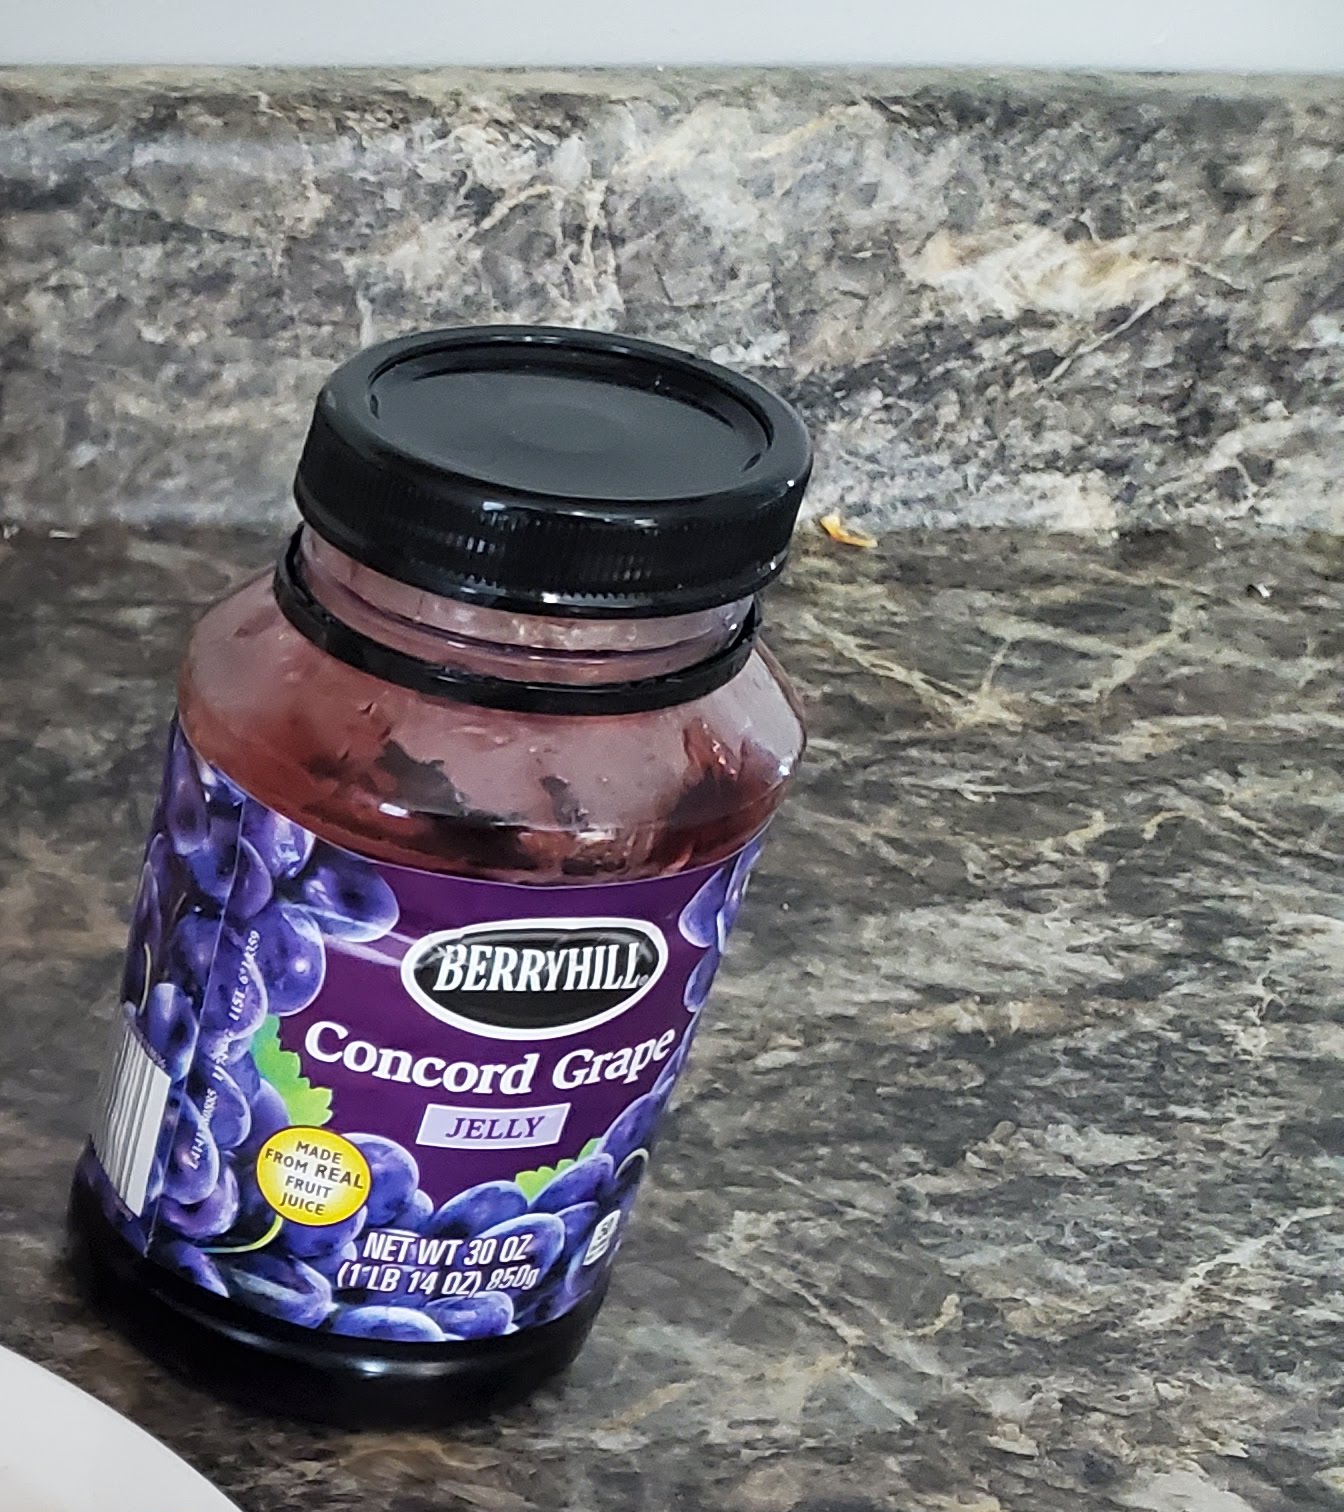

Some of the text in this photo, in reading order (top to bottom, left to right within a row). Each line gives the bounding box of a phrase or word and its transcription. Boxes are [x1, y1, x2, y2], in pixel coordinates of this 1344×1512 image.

[432, 942, 641, 993] BERRYHILL
[304, 1020, 676, 1095] Concord Grape
[445, 1115, 545, 1140] JELLY
[265, 1147, 364, 1190] FROM REAL
[295, 1140, 343, 1165] MADE
[279, 1192, 326, 1216] JUICE
[284, 1175, 332, 1199] FRUIT
[362, 1232, 534, 1266] NET WT 30 OZ
[337, 1260, 541, 1299] (1 LB 14 OZ) 850g
